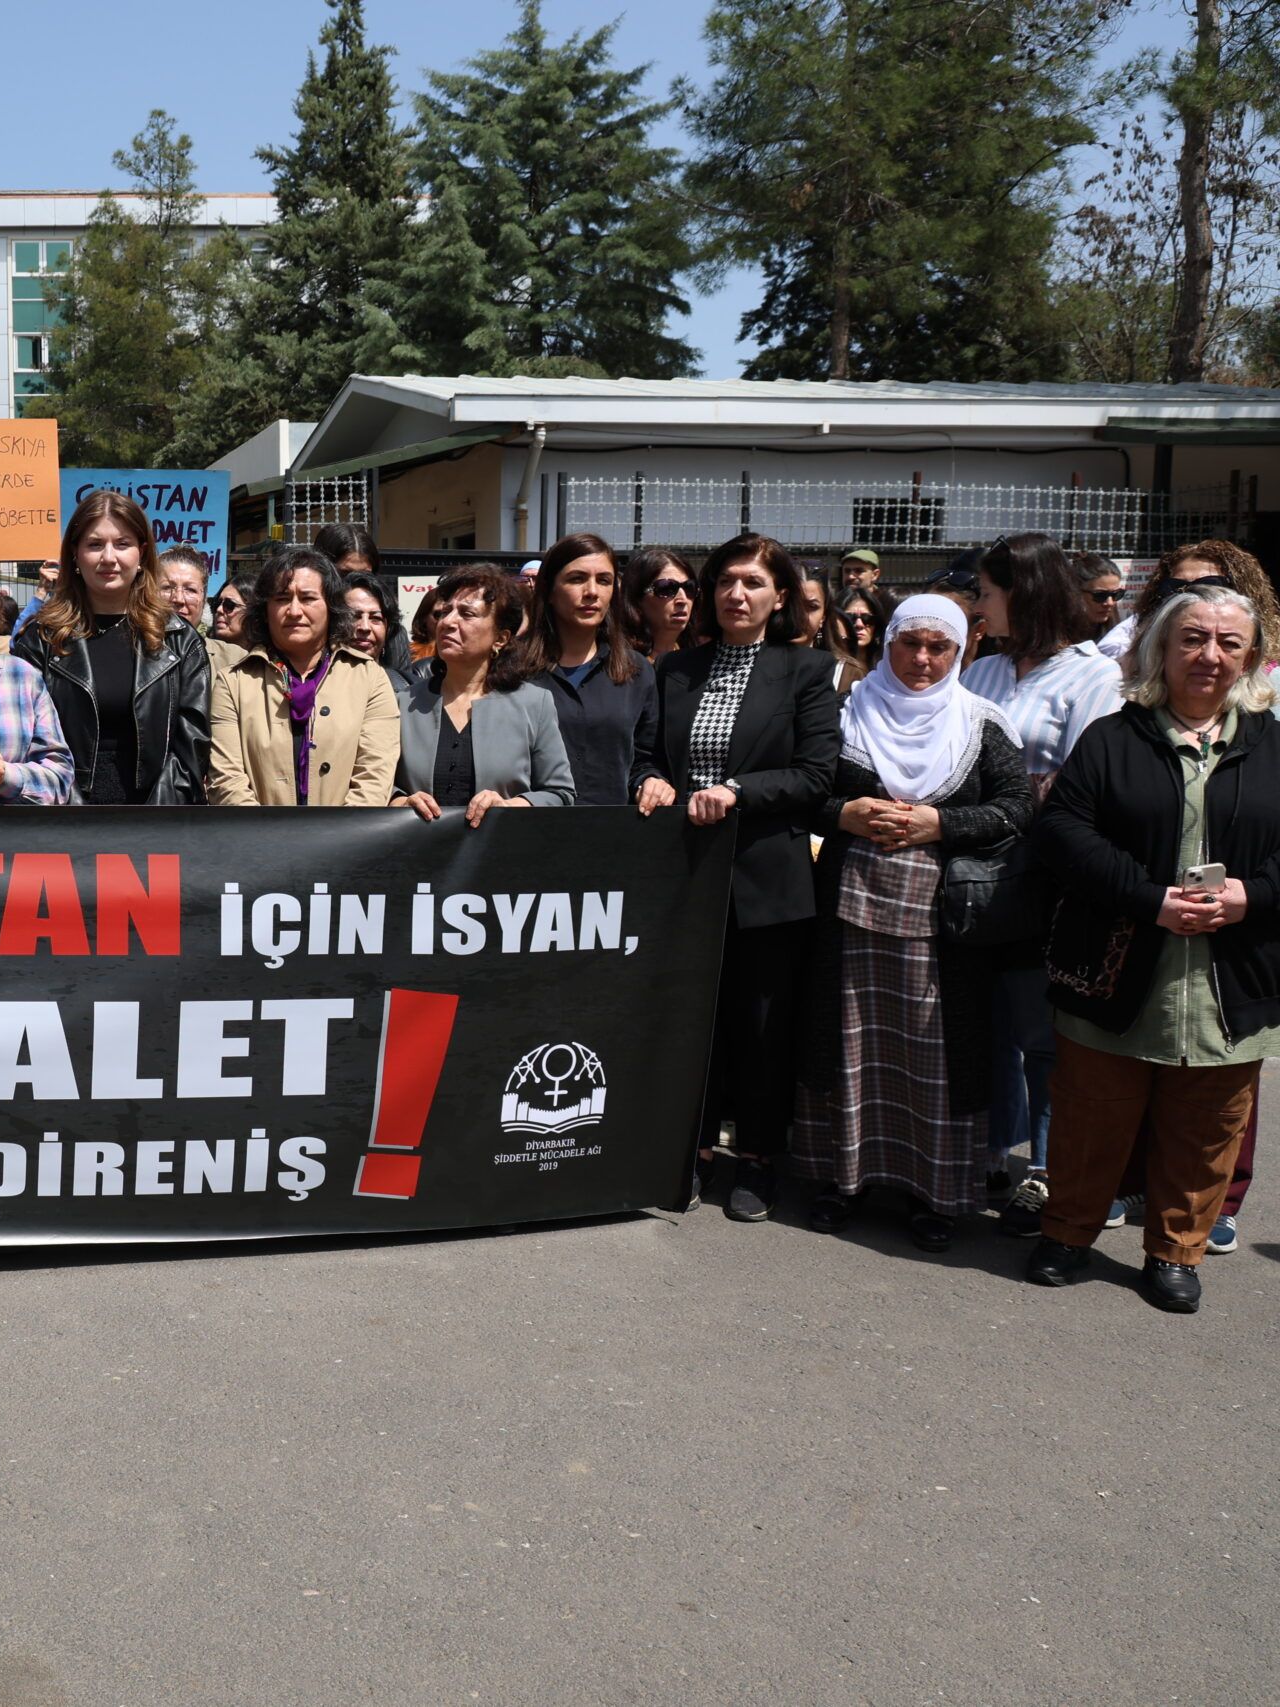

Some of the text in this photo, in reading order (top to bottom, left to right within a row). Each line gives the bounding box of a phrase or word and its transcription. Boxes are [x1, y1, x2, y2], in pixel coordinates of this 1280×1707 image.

[152, 519, 216, 544] DALET
[221, 882, 386, 969] İÇİN
[411, 882, 639, 956] İSYAN,
[525, 1138, 576, 1151] DİYARBAKIR
[494, 1152, 538, 1164] ŞİDDETLE
[539, 1147, 585, 1160] MÜCADELE
[538, 1161, 558, 1171] 2019
